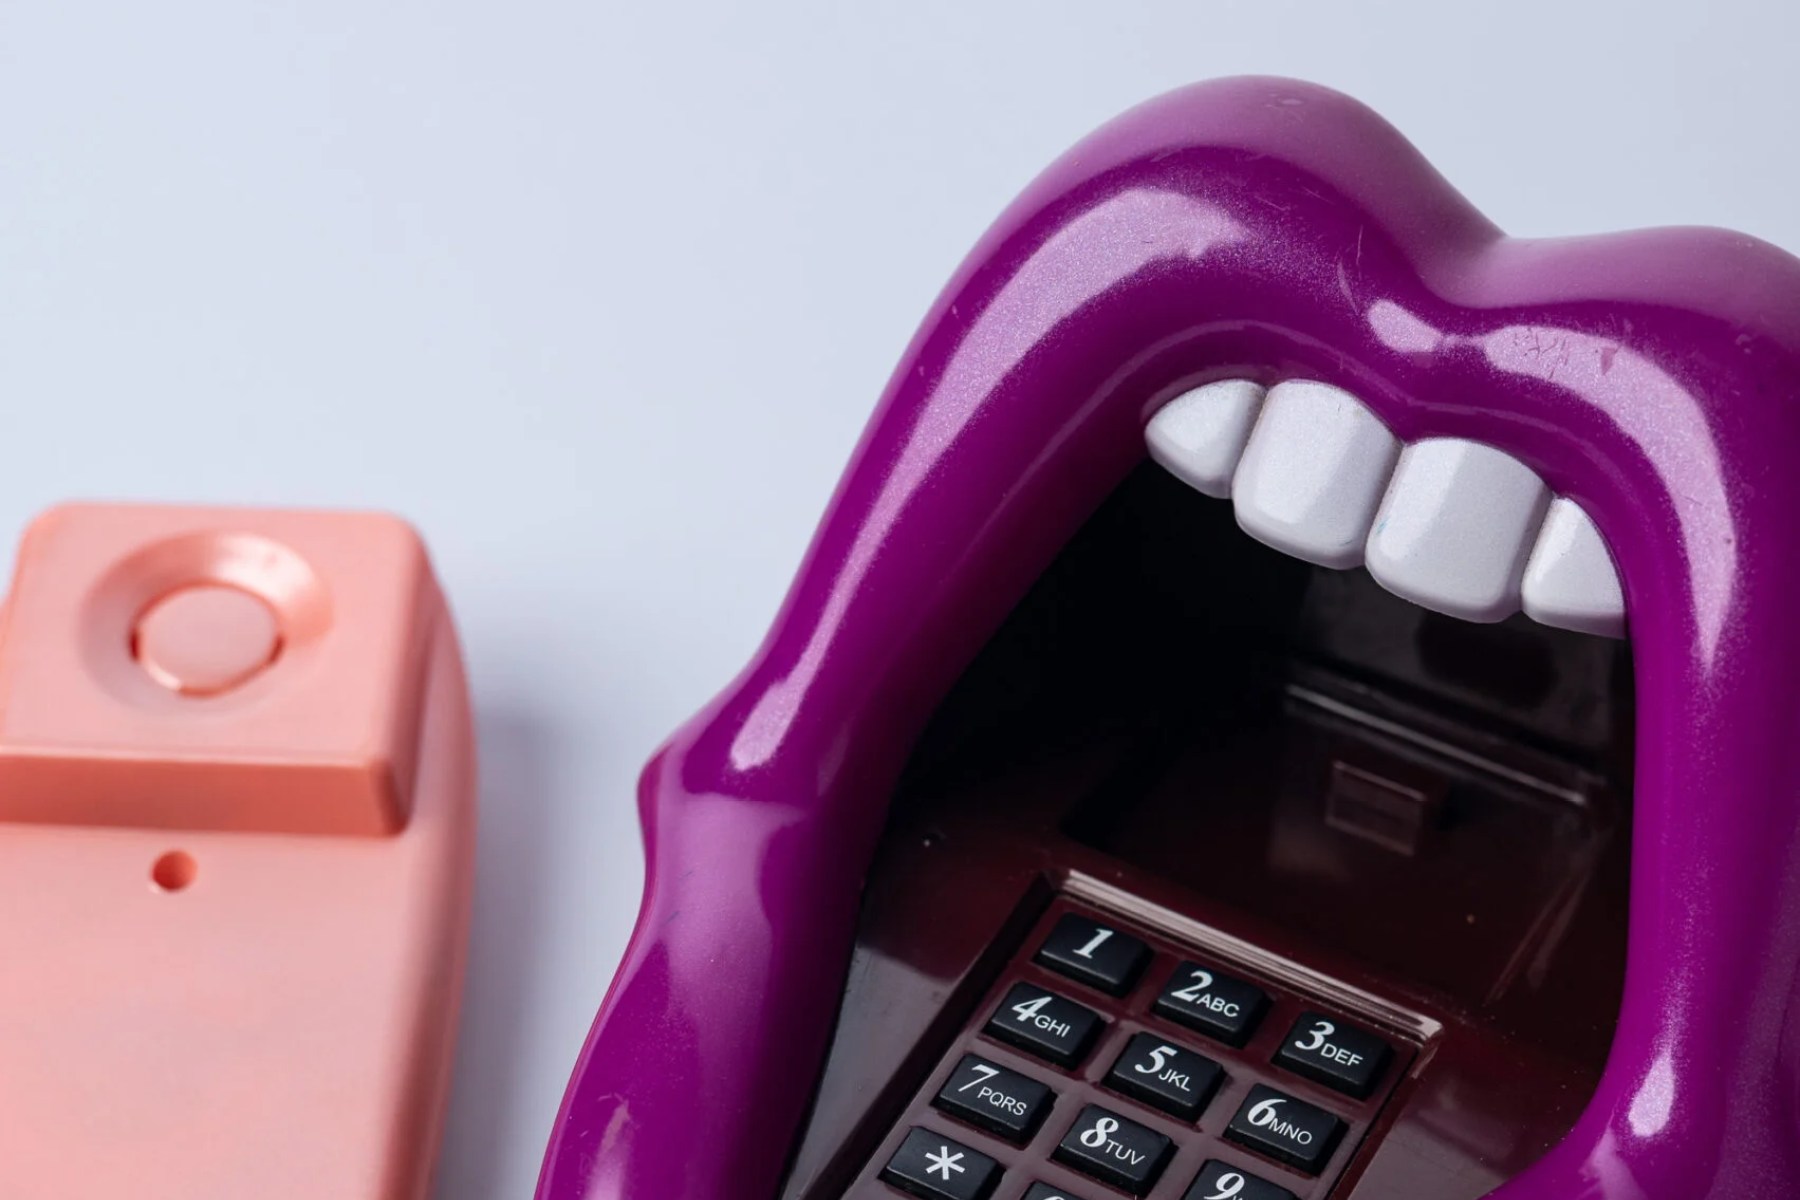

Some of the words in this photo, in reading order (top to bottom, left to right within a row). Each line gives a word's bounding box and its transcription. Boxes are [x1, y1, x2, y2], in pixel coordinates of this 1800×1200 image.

[1073, 929, 1113, 959] 1
[1171, 970, 1213, 1002] 2
[1196, 993, 1240, 1019] ABC
[1011, 996, 1052, 1022] 4
[1034, 1014, 1071, 1038] GHI
[1294, 1021, 1336, 1051] 3
[1320, 1043, 1363, 1067] DEF
[958, 1063, 1000, 1093] 7
[1134, 1045, 1177, 1074] 5
[1158, 1068, 1191, 1092] JKL
[976, 1086, 1027, 1116] PQRS
[1247, 1098, 1288, 1129] 6
[1269, 1116, 1313, 1145] MNO
[1079, 1117, 1120, 1148] 8
[1105, 1138, 1146, 1166] TUV
[1203, 1172, 1245, 1200] 9
